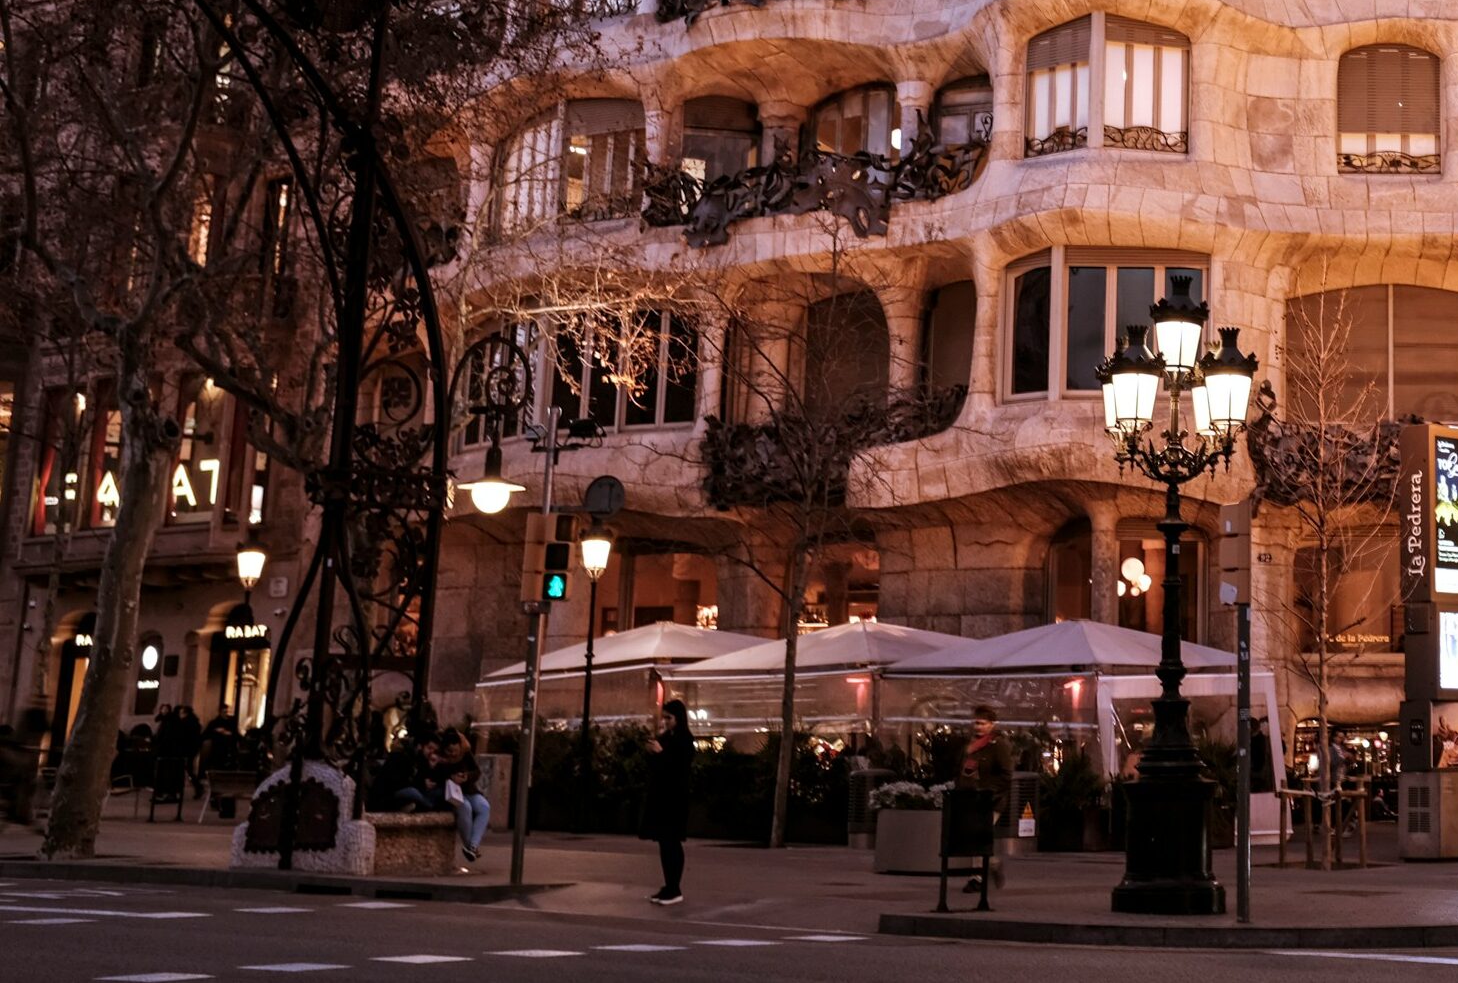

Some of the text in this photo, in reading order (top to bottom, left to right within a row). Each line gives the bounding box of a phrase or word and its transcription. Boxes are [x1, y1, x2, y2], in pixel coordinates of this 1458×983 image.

[1407, 470, 1426, 577] La Pedrera
[225, 624, 267, 638] RABAT
